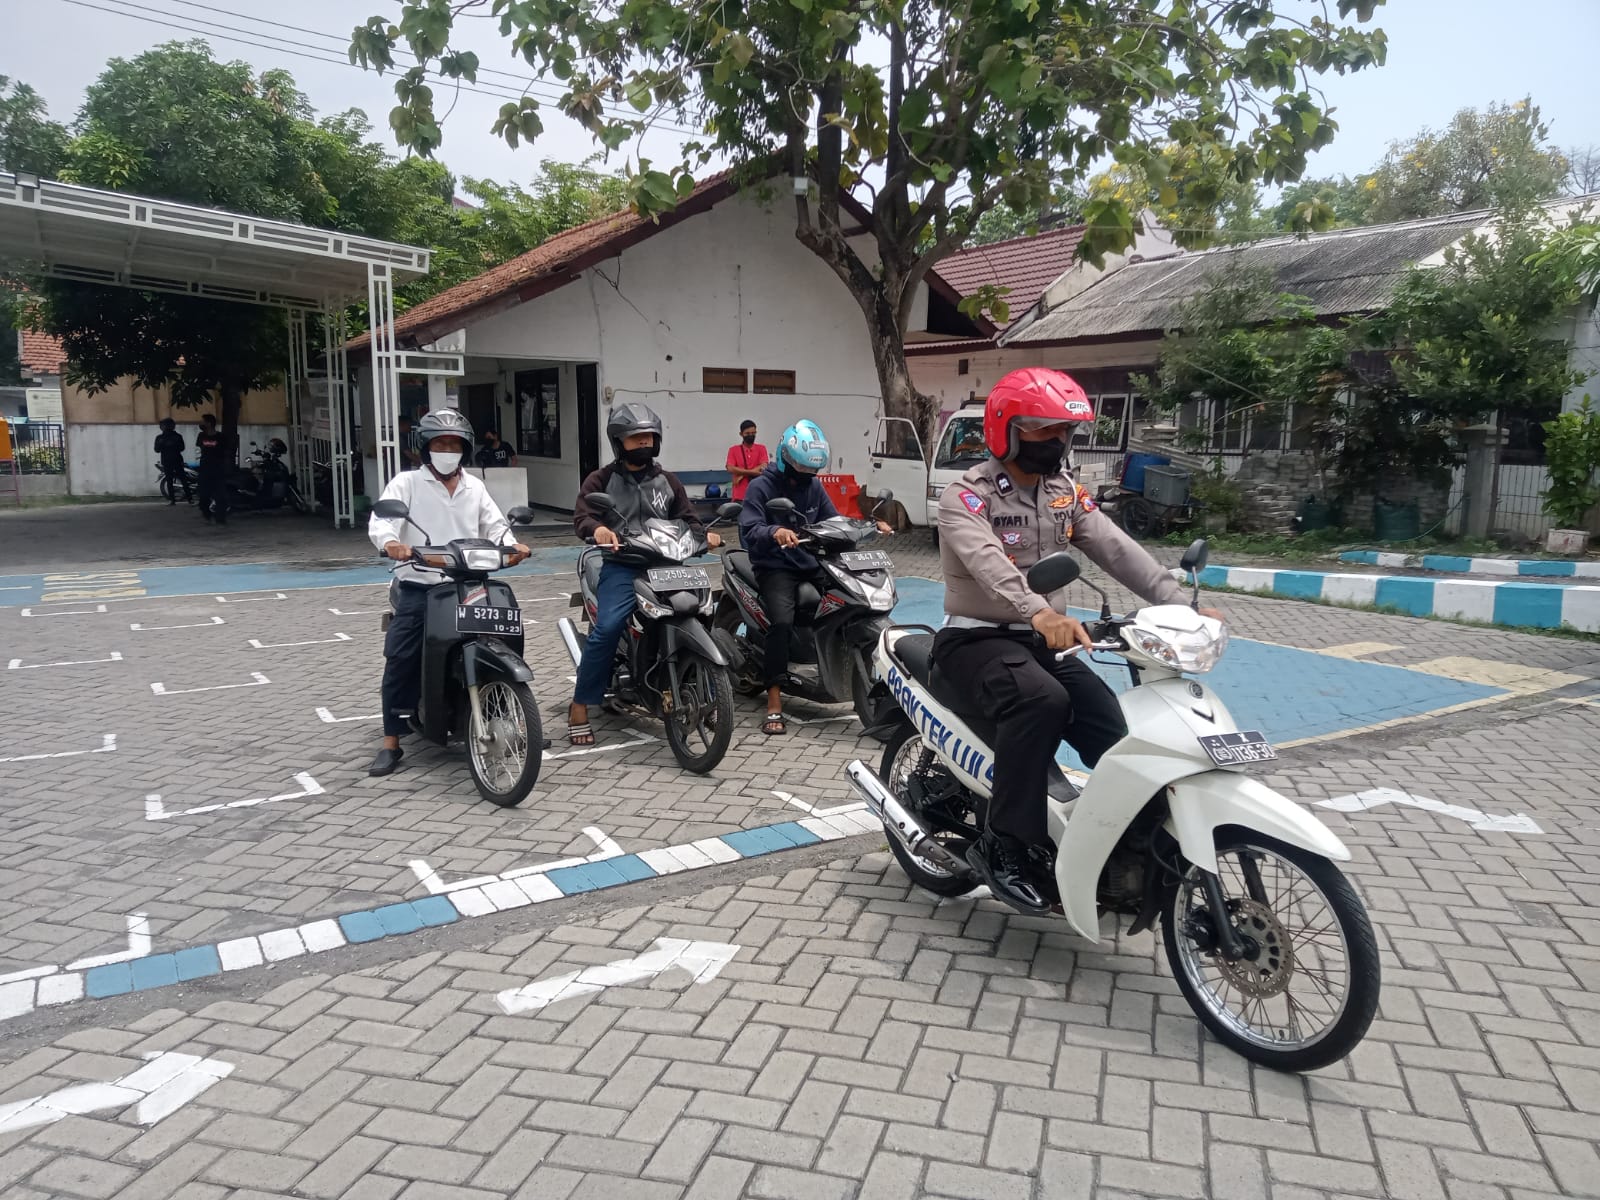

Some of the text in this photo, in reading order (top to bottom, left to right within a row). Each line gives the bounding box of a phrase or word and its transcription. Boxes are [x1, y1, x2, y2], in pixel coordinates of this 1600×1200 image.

[650, 570, 658, 580] W
[665, 568, 688, 579] 2505
[458, 607, 519, 621] W 5273 BI
[494, 624, 520, 633] 10-23
[887, 666, 953, 754] PRAKTEK
[1231, 743, 1275, 760] 1136-30
